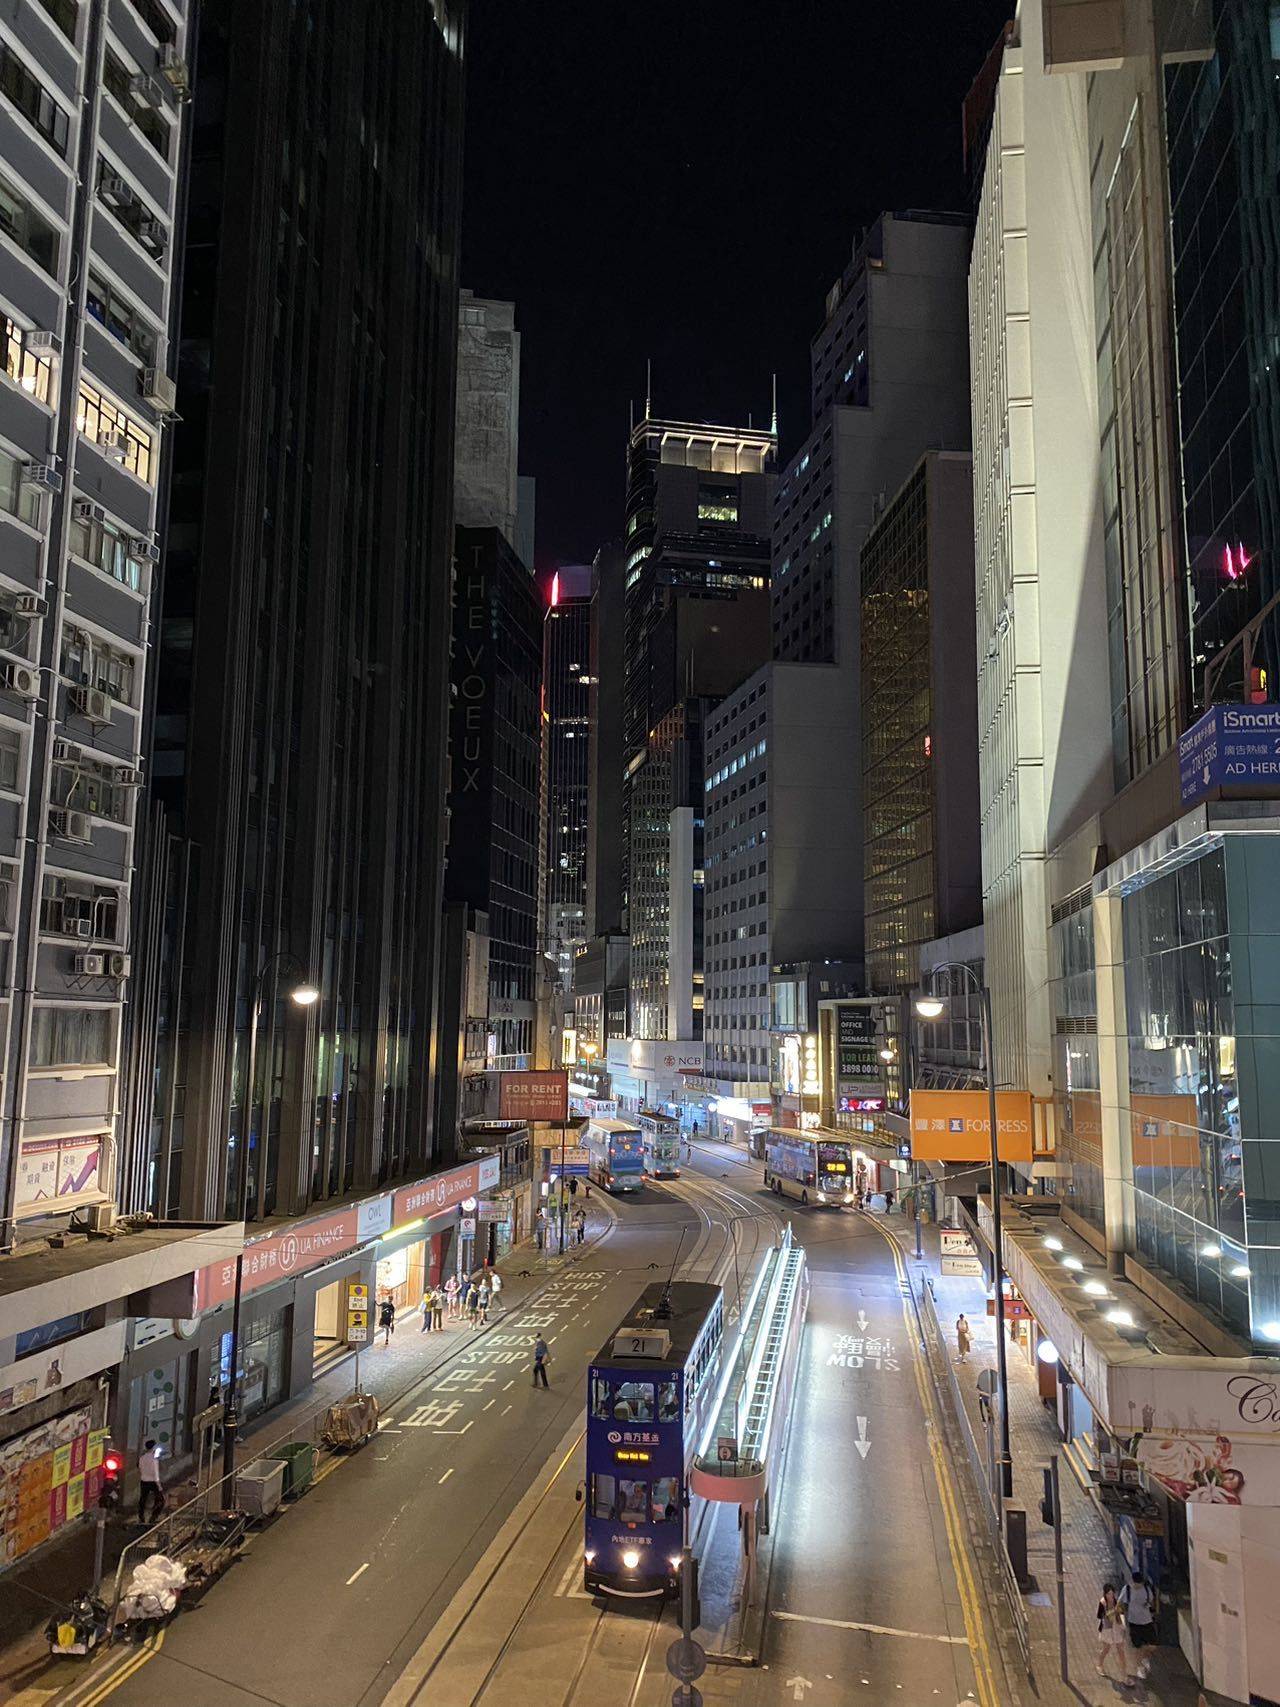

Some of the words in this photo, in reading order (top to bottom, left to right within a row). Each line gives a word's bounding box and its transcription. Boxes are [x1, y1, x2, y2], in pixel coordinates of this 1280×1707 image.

[464, 545, 485, 629] THE
[461, 644, 487, 792] VOEUX
[1224, 711, 1280, 728] iSmart
[1225, 763, 1247, 774] AD
[1251, 763, 1280, 774] HER
[841, 1021, 863, 1029] OFFICE
[678, 1056, 702, 1066] NCB
[506, 1084, 529, 1094] FOR
[531, 1084, 562, 1094] RENT
[966, 1119, 1028, 1132] FORRESS
[300, 1237, 312, 1255] UA
[313, 1224, 344, 1251] FINANCE
[565, 1271, 606, 1279] BUS
[548, 1282, 600, 1290] STOP
[531, 1293, 580, 1308] 巴士
[514, 1311, 560, 1328] 站
[485, 1335, 537, 1347] BUS
[632, 1338, 646, 1353] 21
[461, 1351, 529, 1364] STOP
[826, 1354, 902, 1371] SLOW
[592, 1369, 599, 1378] 21
[671, 1372, 679, 1381] 21
[432, 1369, 497, 1392] 巴士
[399, 1399, 464, 1427] 站
